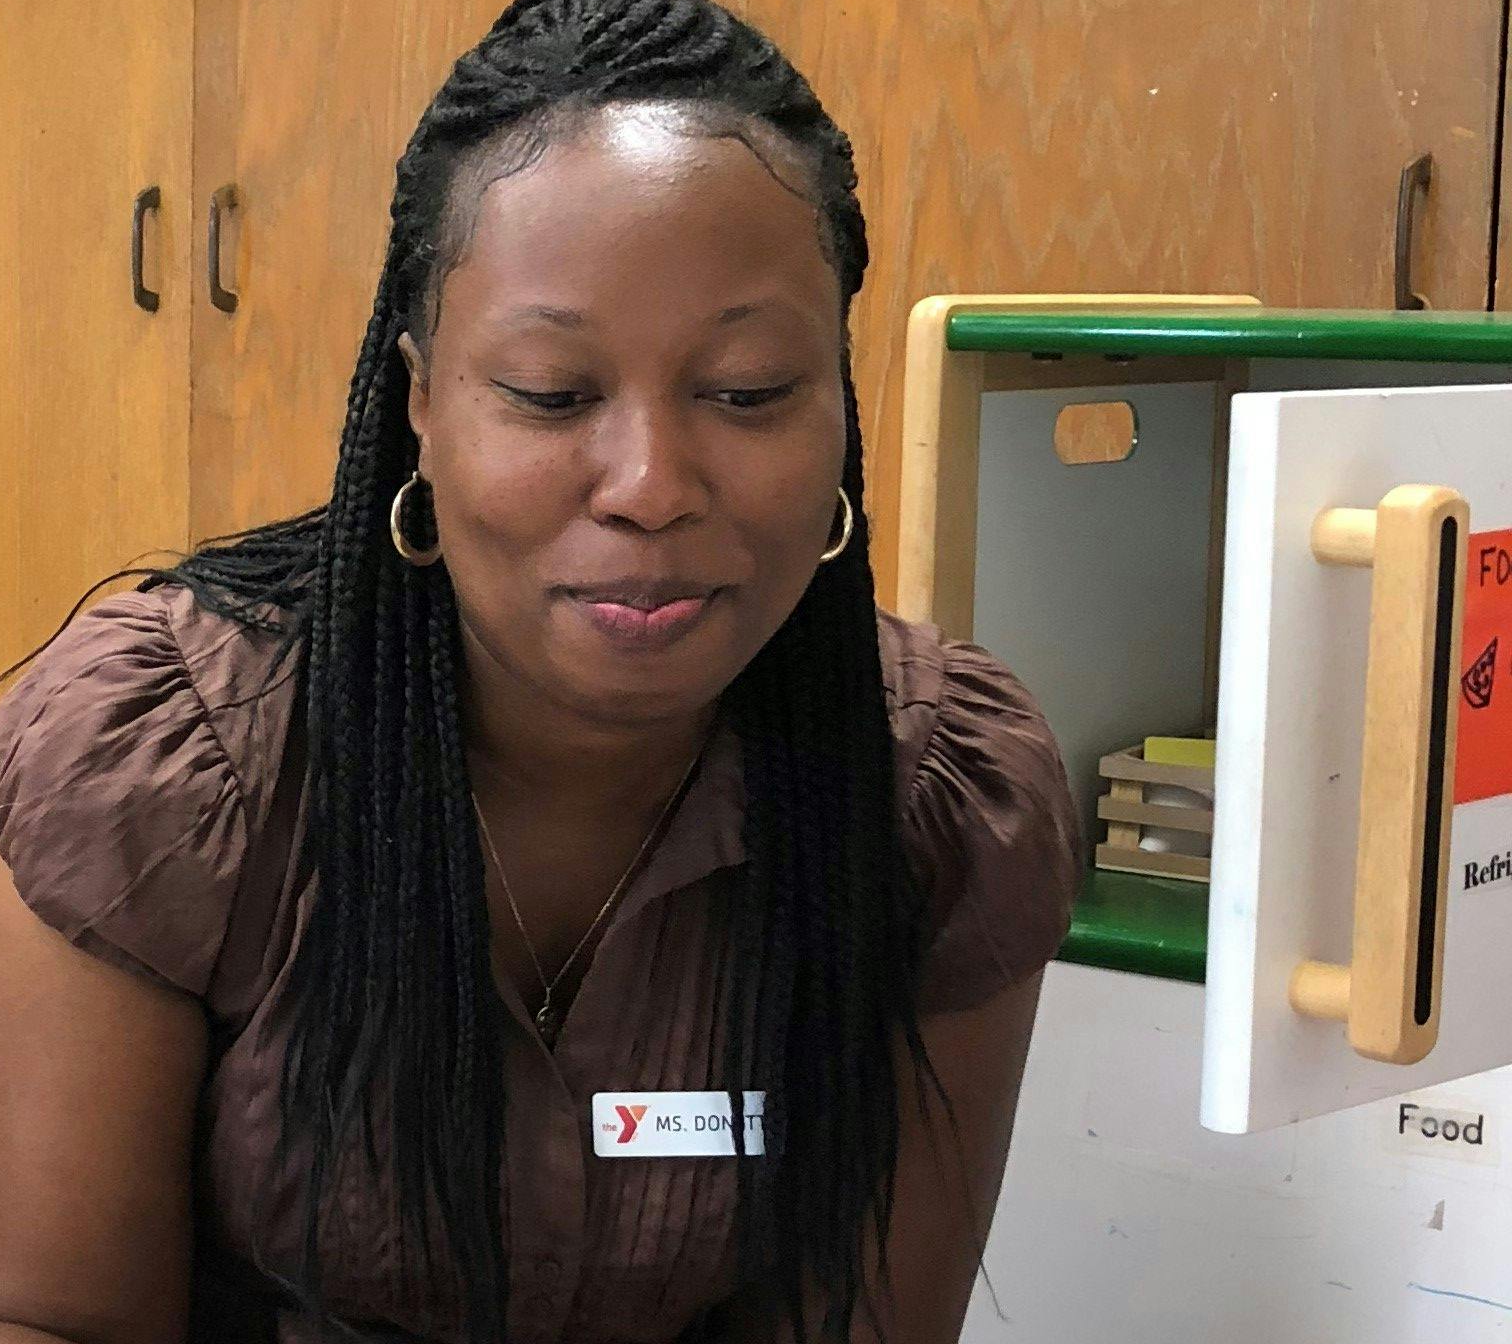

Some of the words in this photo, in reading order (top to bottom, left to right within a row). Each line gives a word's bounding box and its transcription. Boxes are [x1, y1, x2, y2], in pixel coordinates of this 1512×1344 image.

[1480, 545, 1512, 587] FO
[1464, 851, 1512, 890] Refri
[602, 1123, 617, 1132] the
[656, 1115, 688, 1132] MS.
[1398, 1103, 1484, 1145] Food
